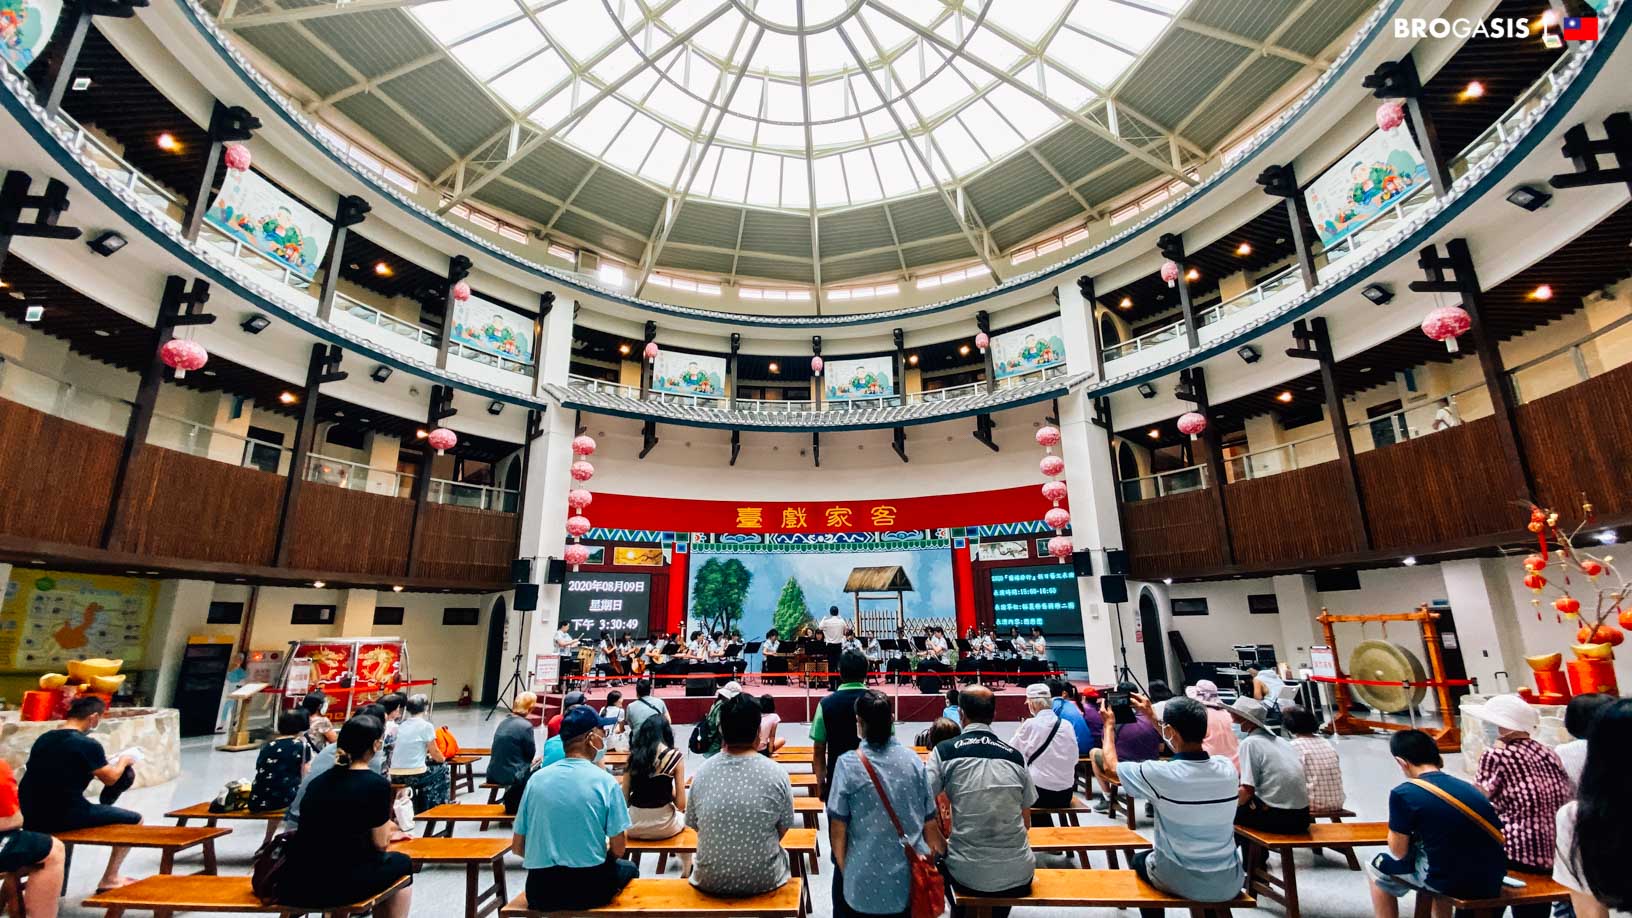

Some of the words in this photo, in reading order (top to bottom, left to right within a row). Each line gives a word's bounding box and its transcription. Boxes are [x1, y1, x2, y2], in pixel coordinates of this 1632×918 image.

[568, 580, 645, 592] 2020年08月09日
[589, 599, 623, 611] 星期日
[571, 619, 595, 631] 下午
[599, 619, 639, 630] 3:30:49
